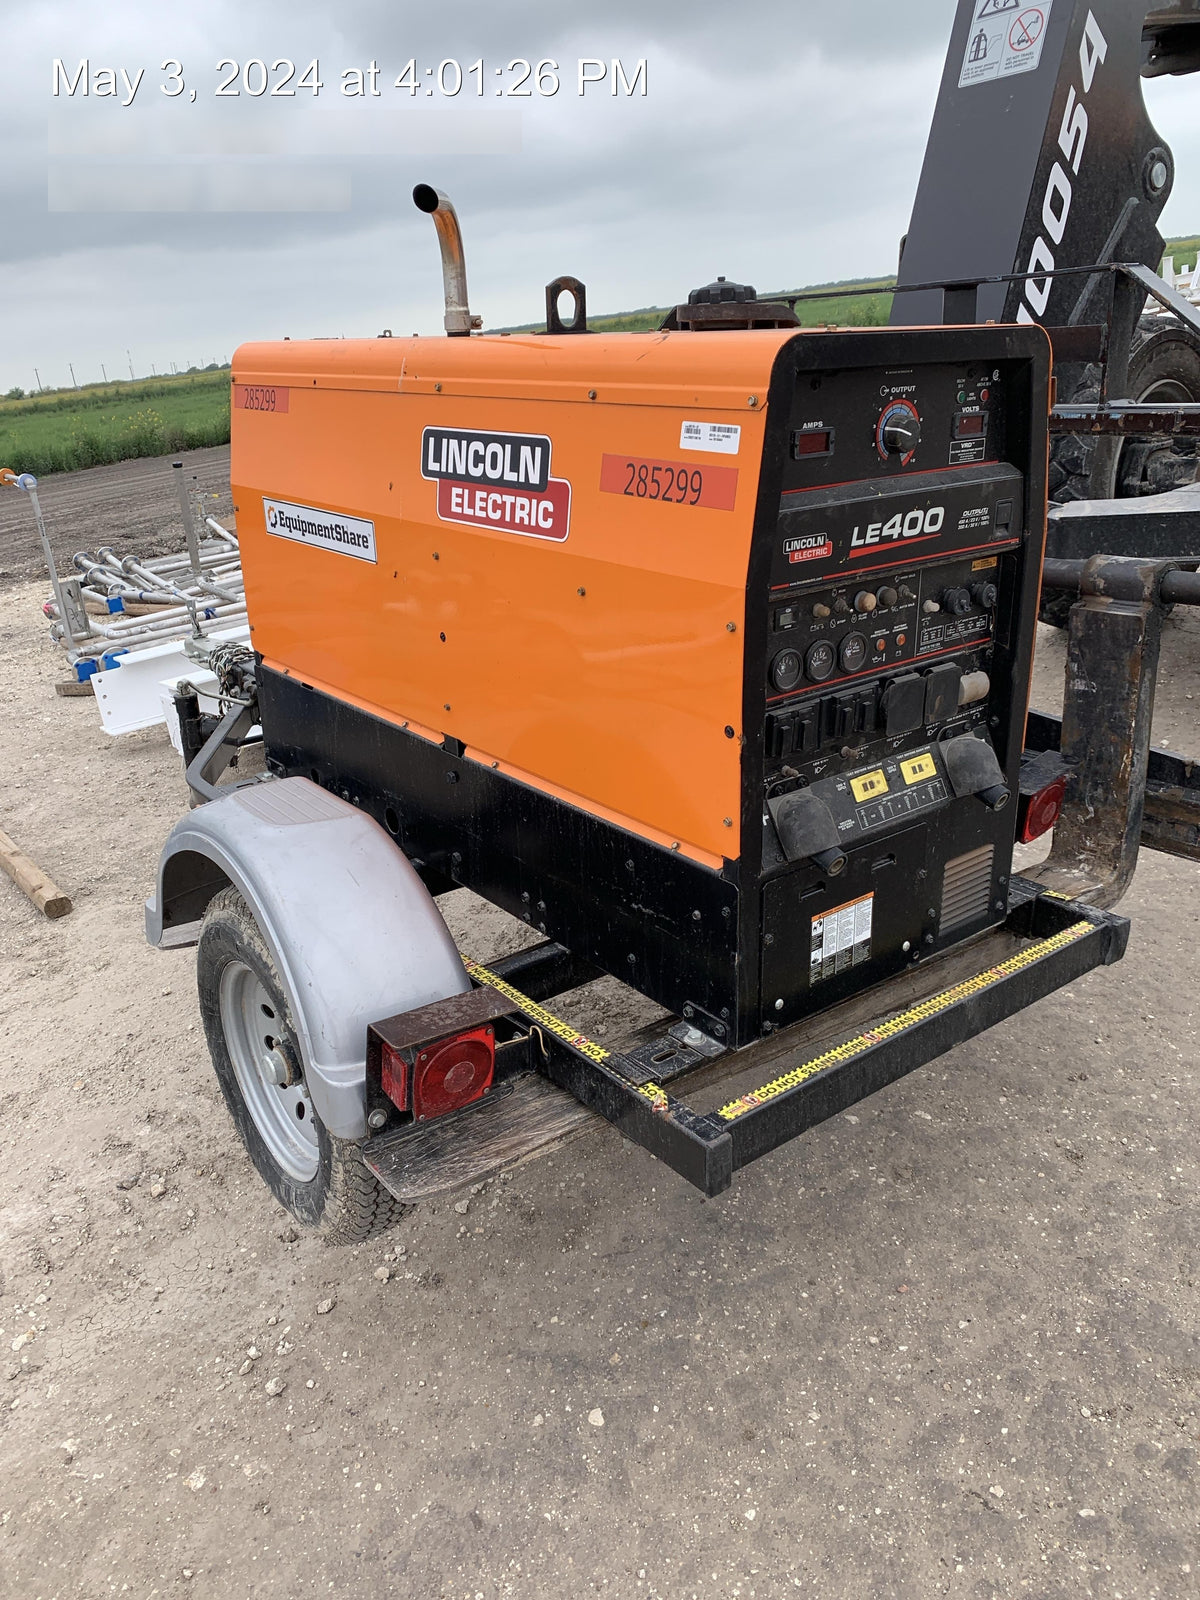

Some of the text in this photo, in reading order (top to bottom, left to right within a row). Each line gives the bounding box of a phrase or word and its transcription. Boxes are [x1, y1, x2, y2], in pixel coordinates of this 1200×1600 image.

[244, 387, 277, 412] 285299
[802, 420, 824, 429] AMPS
[427, 437, 542, 485] LINCOLN
[624, 463, 703, 505] 285299
[451, 486, 554, 529] ELECTRIC
[851, 506, 945, 547] LE400
[278, 510, 369, 549] EquipmentShare
[786, 536, 824, 552] LINCOLN
[794, 547, 828, 560] ELECTRIC
[472, 967, 601, 1056] NE PAS TENEZ DEBOUT ICI NO
[757, 1087, 777, 1098] DO
[777, 1073, 800, 1089] NOT
[801, 1055, 838, 1075] STAND
[837, 1039, 866, 1057] HERE
[877, 1026, 892, 1036] NE
[892, 1016, 914, 1027] PAS
[911, 1000, 943, 1017] TENEZ
[980, 974, 995, 983] ICI
[1003, 963, 1018, 972] NO
